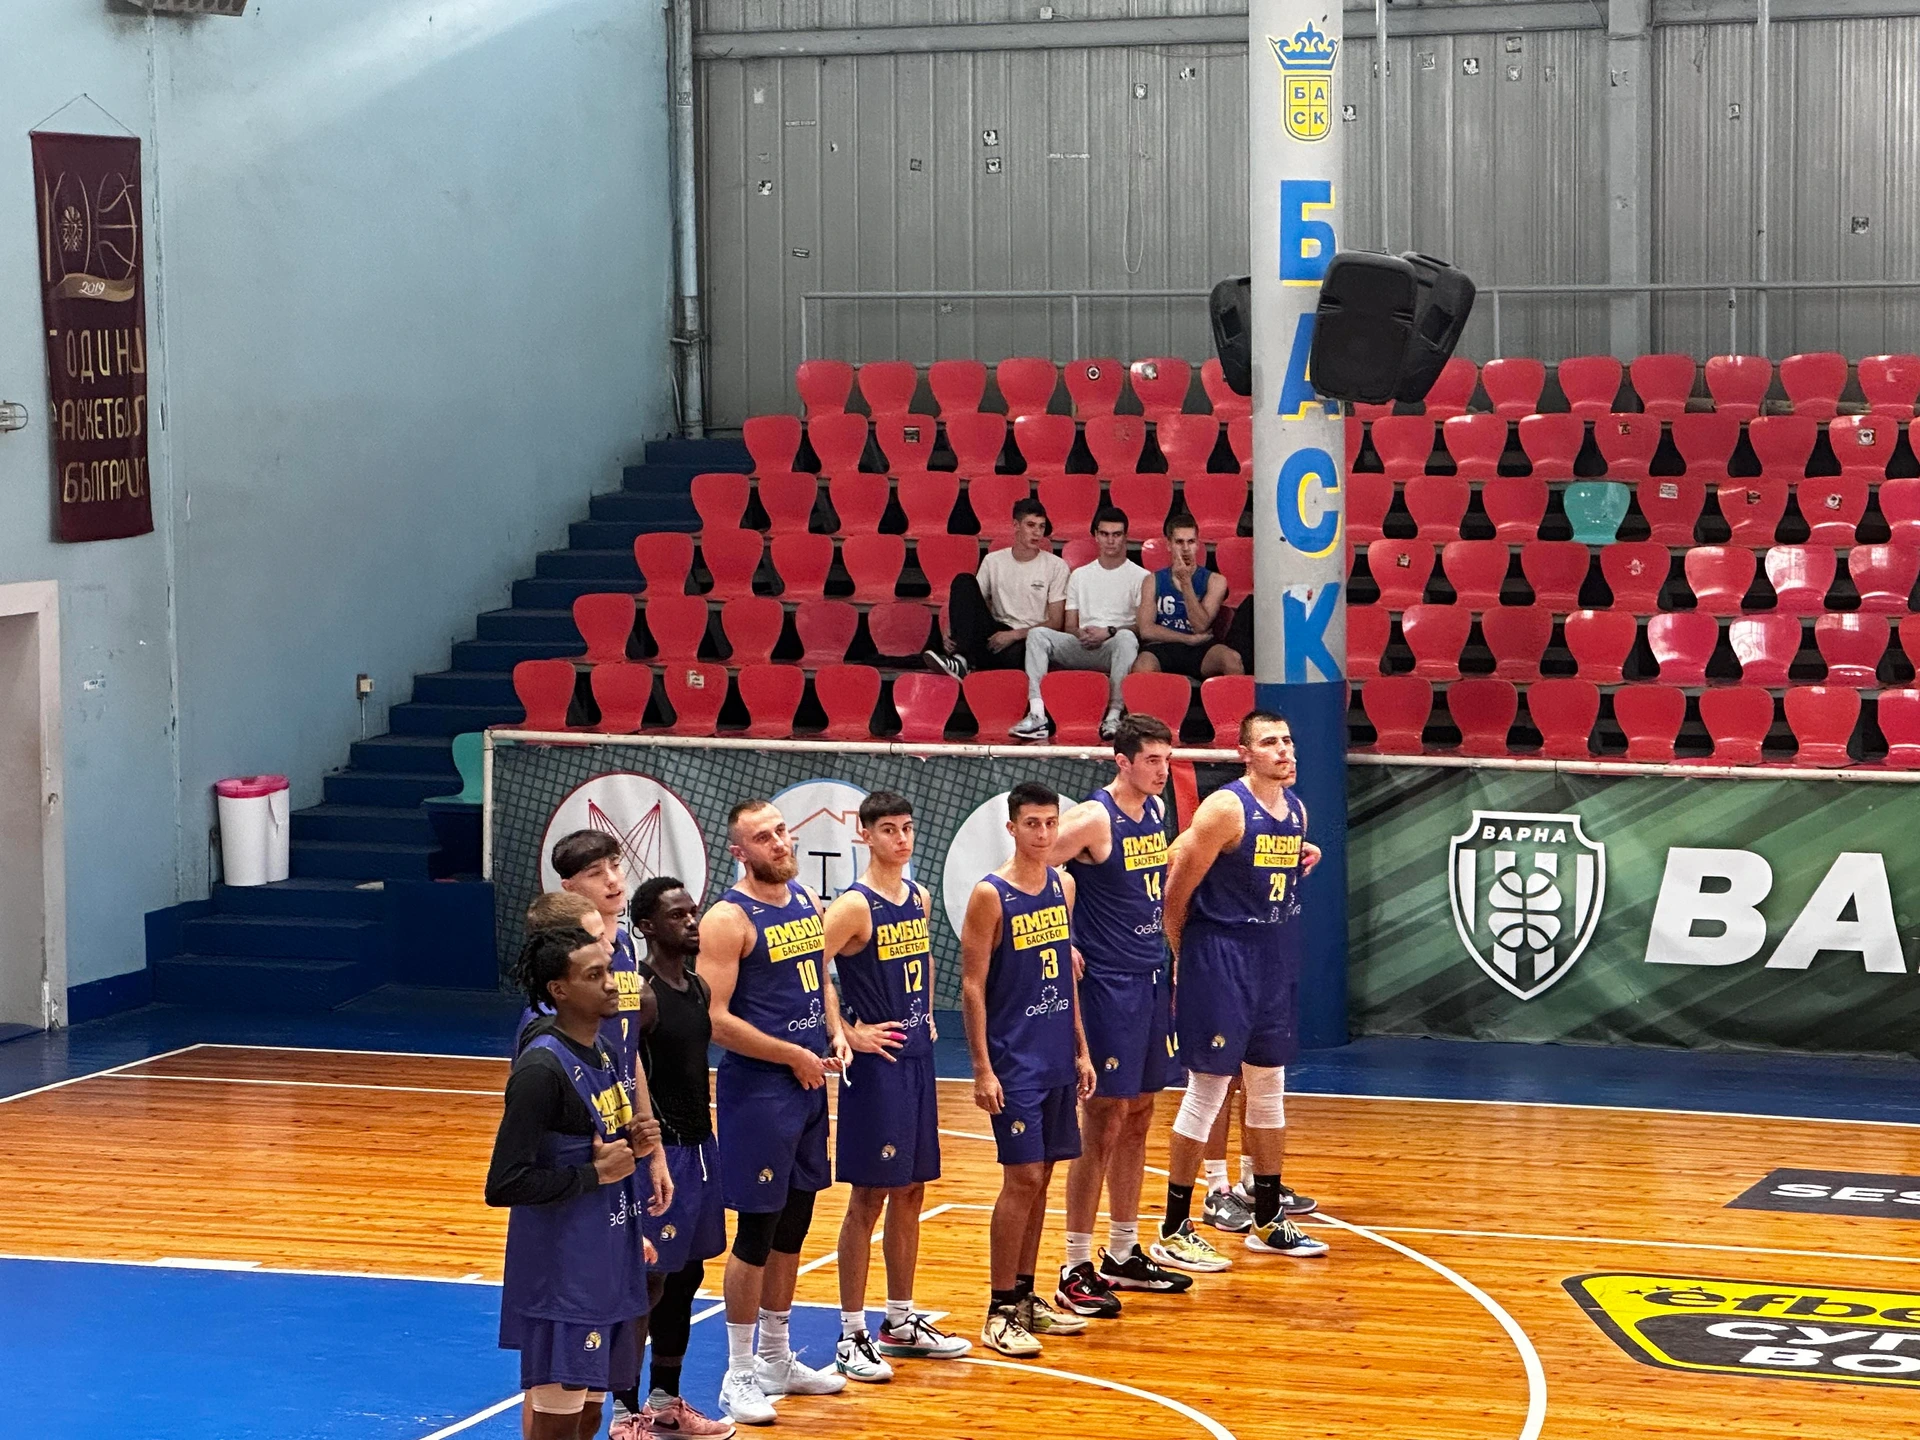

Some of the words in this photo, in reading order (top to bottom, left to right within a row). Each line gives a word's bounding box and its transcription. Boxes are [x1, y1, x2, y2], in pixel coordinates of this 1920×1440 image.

[78, 280, 106, 297] 2019
[49, 327, 145, 385] ОДИНИ
[52, 394, 146, 441] АСКЕТБОЛ
[1482, 825, 1567, 843] ВАРНА
[1644, 847, 1920, 974] ВА
[764, 914, 824, 948] ЯМБОЛ
[797, 959, 820, 993] 10
[903, 960, 923, 993] 12
